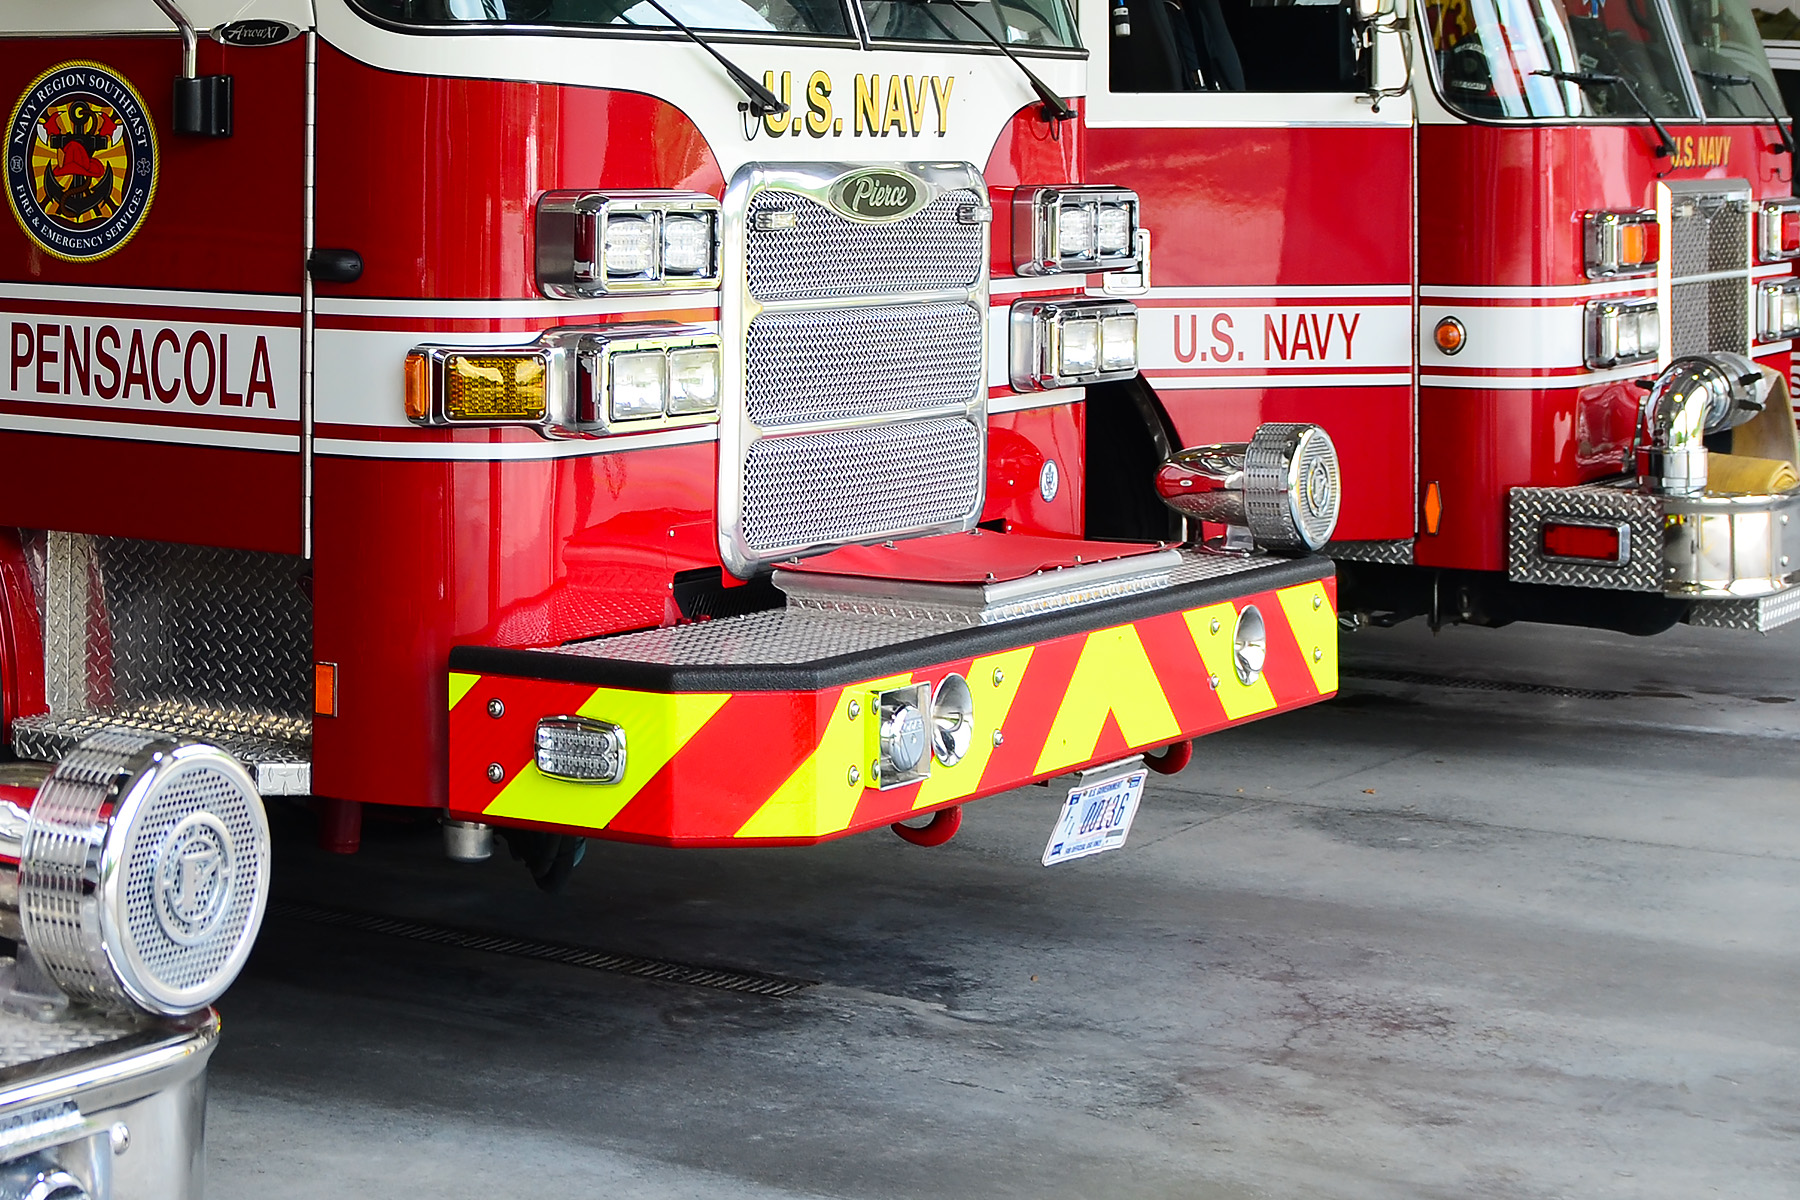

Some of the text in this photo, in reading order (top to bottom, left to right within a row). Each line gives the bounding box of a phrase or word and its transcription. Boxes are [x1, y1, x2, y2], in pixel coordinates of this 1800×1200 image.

[15, 73, 148, 148] NAVY REGION SOUTHEAST
[762, 70, 955, 138] U.S. NAVY
[1671, 136, 1732, 169] U.S. NAVY
[16, 184, 144, 249] FIRE & EMERGENCY SERVICES
[852, 176, 908, 212] Pierce
[11, 322, 277, 410] PENSACOLA
[1173, 312, 1361, 363] U.S. NAVY
[1080, 792, 1130, 835] 00136
